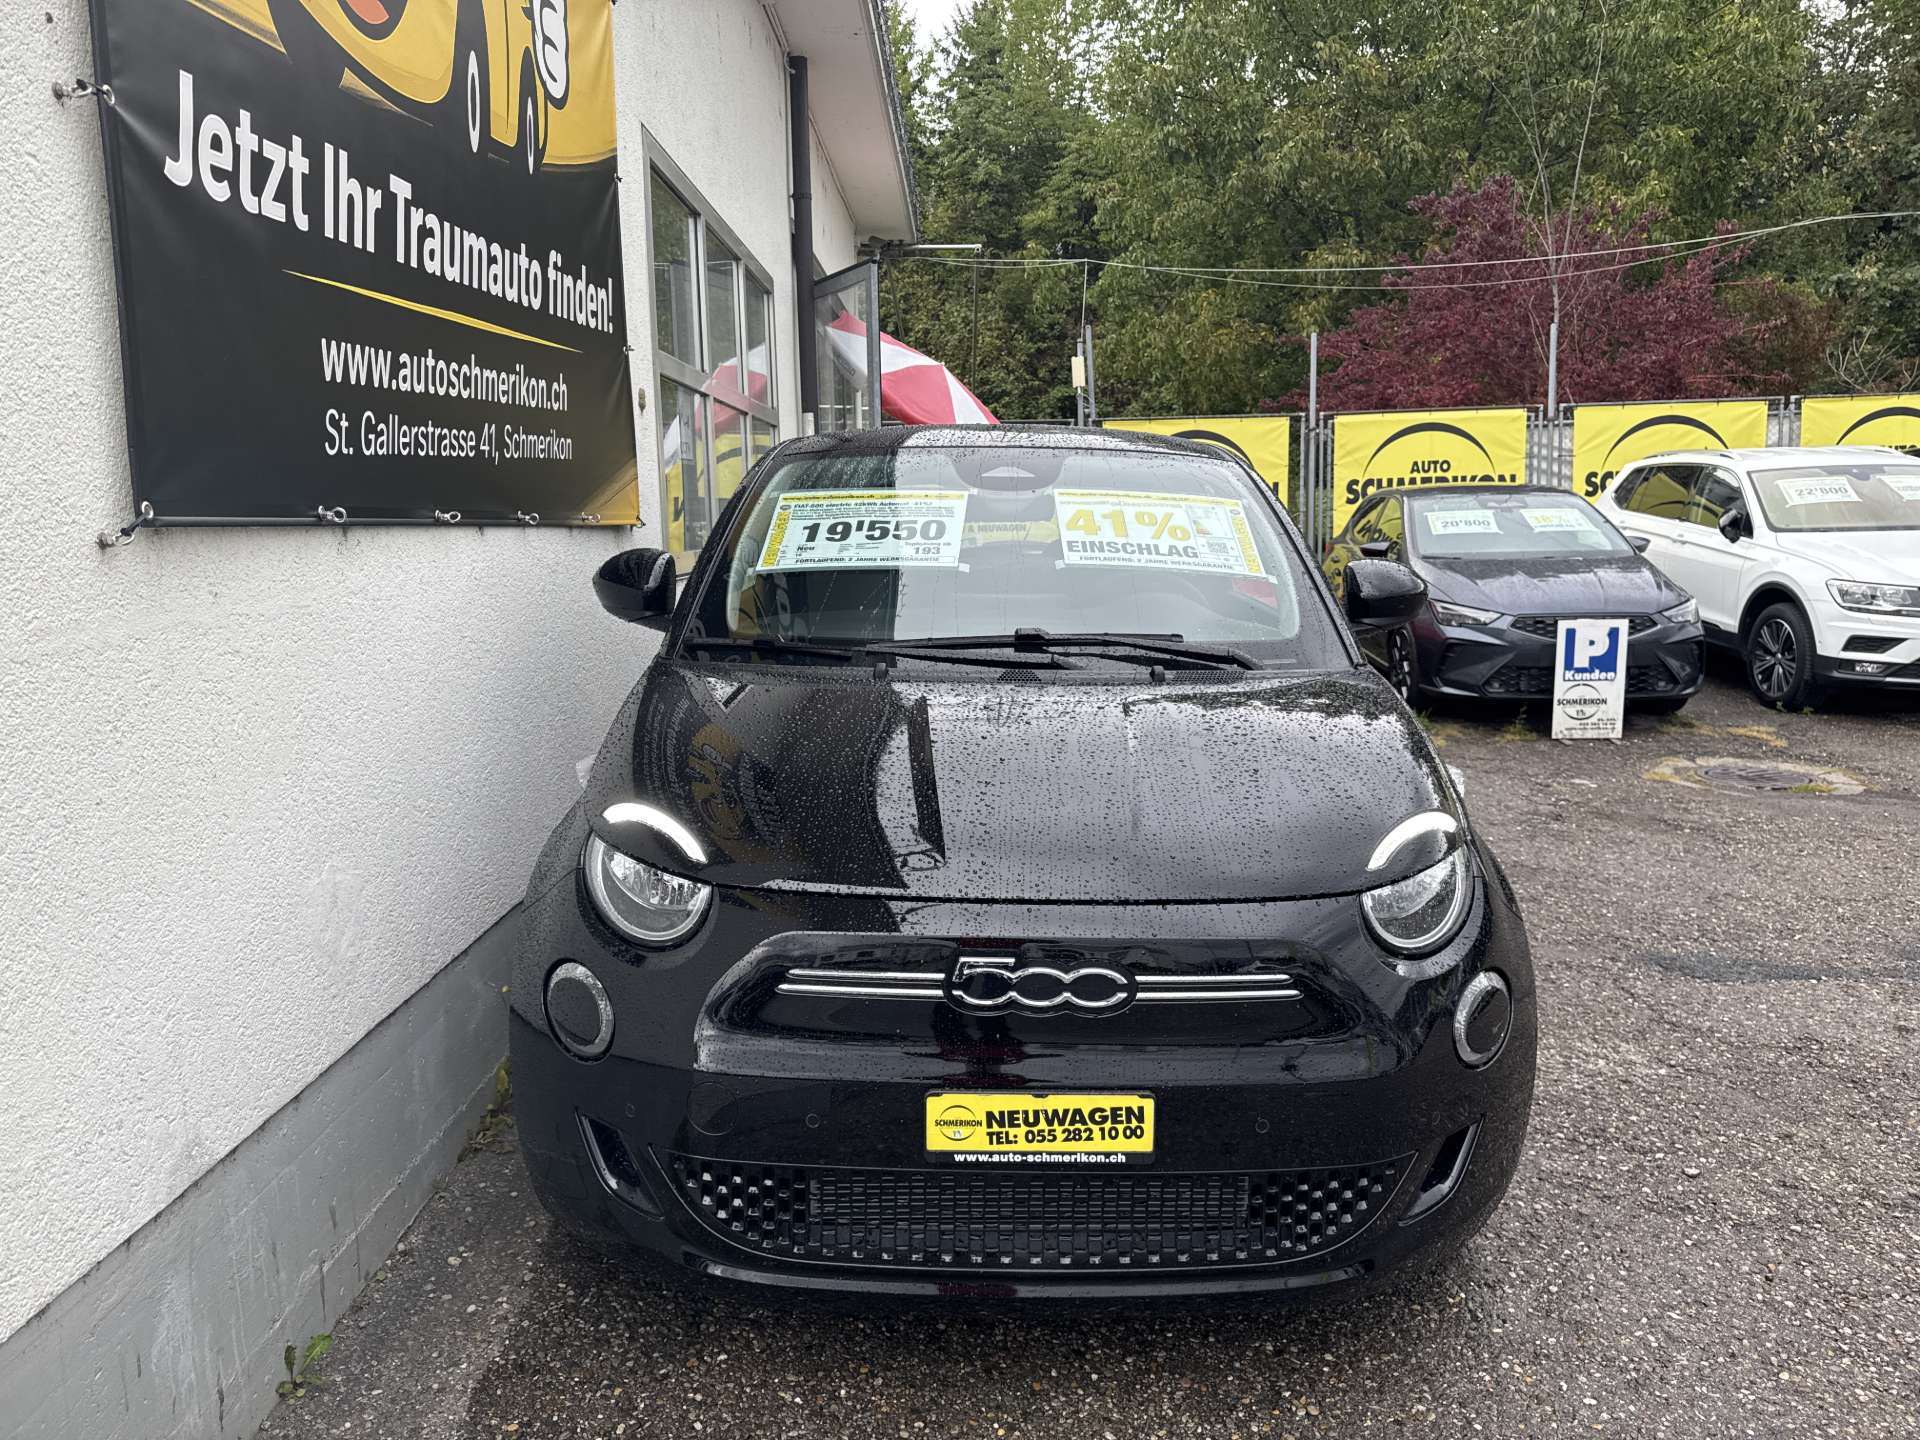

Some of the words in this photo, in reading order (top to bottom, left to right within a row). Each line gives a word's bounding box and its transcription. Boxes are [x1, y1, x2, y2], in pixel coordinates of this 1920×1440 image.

[164, 69, 310, 232] Jetzt
[324, 142, 382, 253] Ihr
[389, 173, 543, 311] Traumauto
[547, 250, 613, 334] finden!
[321, 337, 568, 411] www.autoschmerikon.ch
[324, 408, 354, 456] St.
[361, 410, 476, 458] Gallerstrasse
[479, 422, 499, 465] 41,
[503, 424, 573, 460] Schmerikon
[1410, 460, 1451, 474] AUTO
[802, 519, 947, 543] 19'550
[1065, 508, 1193, 541] 41%
[913, 546, 941, 555] 193
[1066, 540, 1200, 559] EINSCHLAG
[1573, 627, 1610, 668] P
[1565, 669, 1616, 681] Kunden
[1557, 697, 1607, 706] SCHMERIKON
[952, 956, 1129, 1008] 500
[934, 1118, 982, 1128] SCHMERIKON
[985, 1106, 1145, 1129] NEUWAGEN
[986, 1130, 1018, 1146] TEL:
[1024, 1129, 1057, 1144] 055
[1062, 1127, 1094, 1143] 282
[1100, 1126, 1122, 1141] 10
[1122, 1125, 1145, 1140] 00
[954, 1152, 1126, 1164] www.auto-schmerikon.ch
